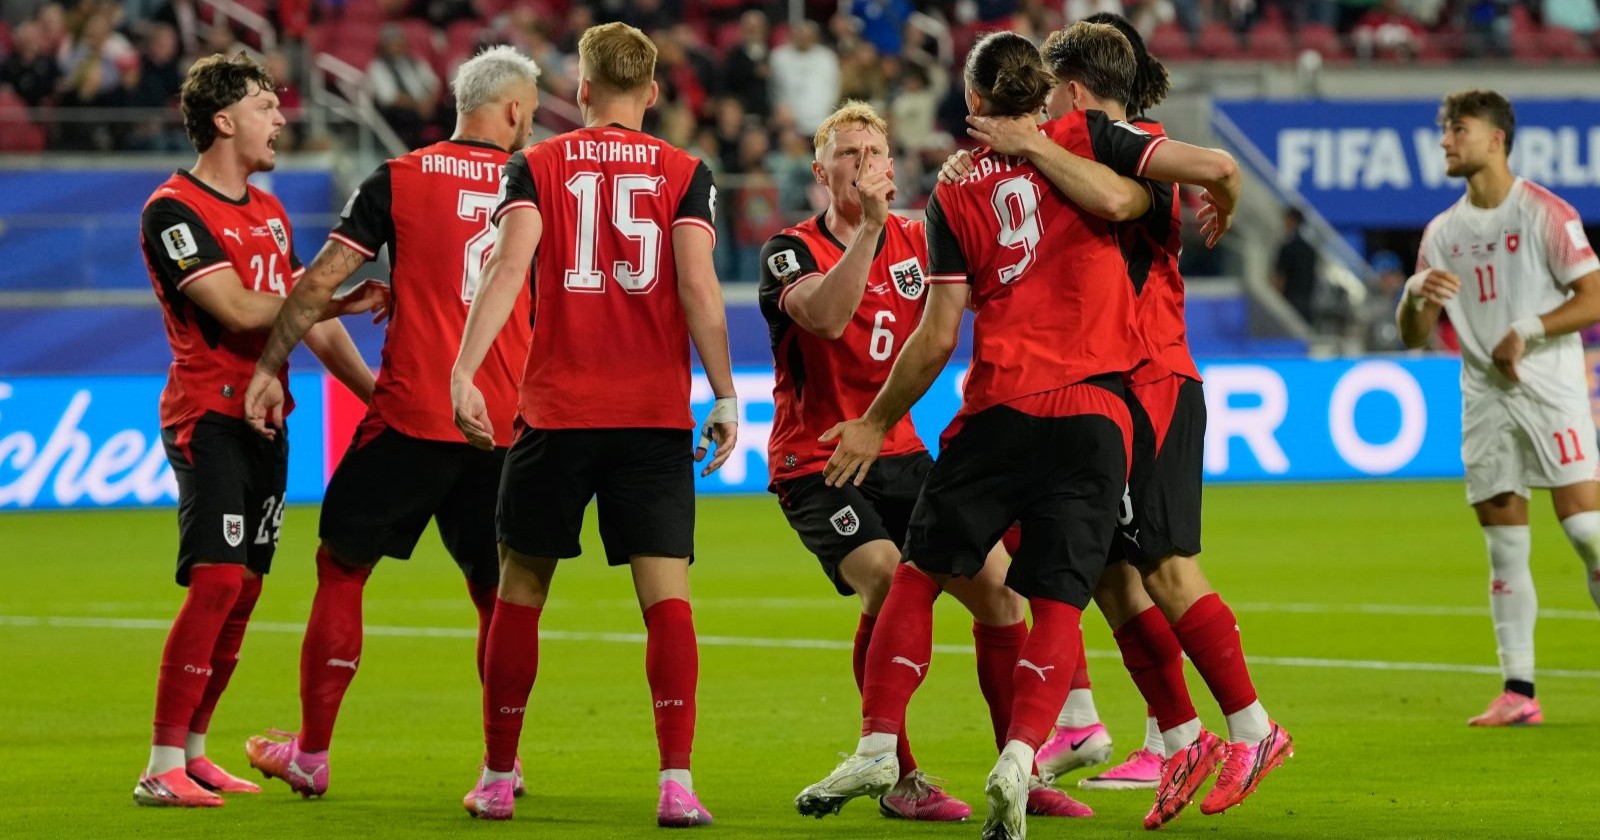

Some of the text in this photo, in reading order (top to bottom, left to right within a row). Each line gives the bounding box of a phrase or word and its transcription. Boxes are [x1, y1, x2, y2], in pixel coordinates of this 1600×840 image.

[564, 139, 661, 166] LIENHART
[1276, 128, 1412, 190] FIFA
[564, 171, 667, 295] 15
[990, 172, 1044, 285] 9
[250, 252, 288, 299] 24
[1474, 264, 1497, 304] 11
[869, 310, 897, 362] 6
[1553, 427, 1585, 465] 11
